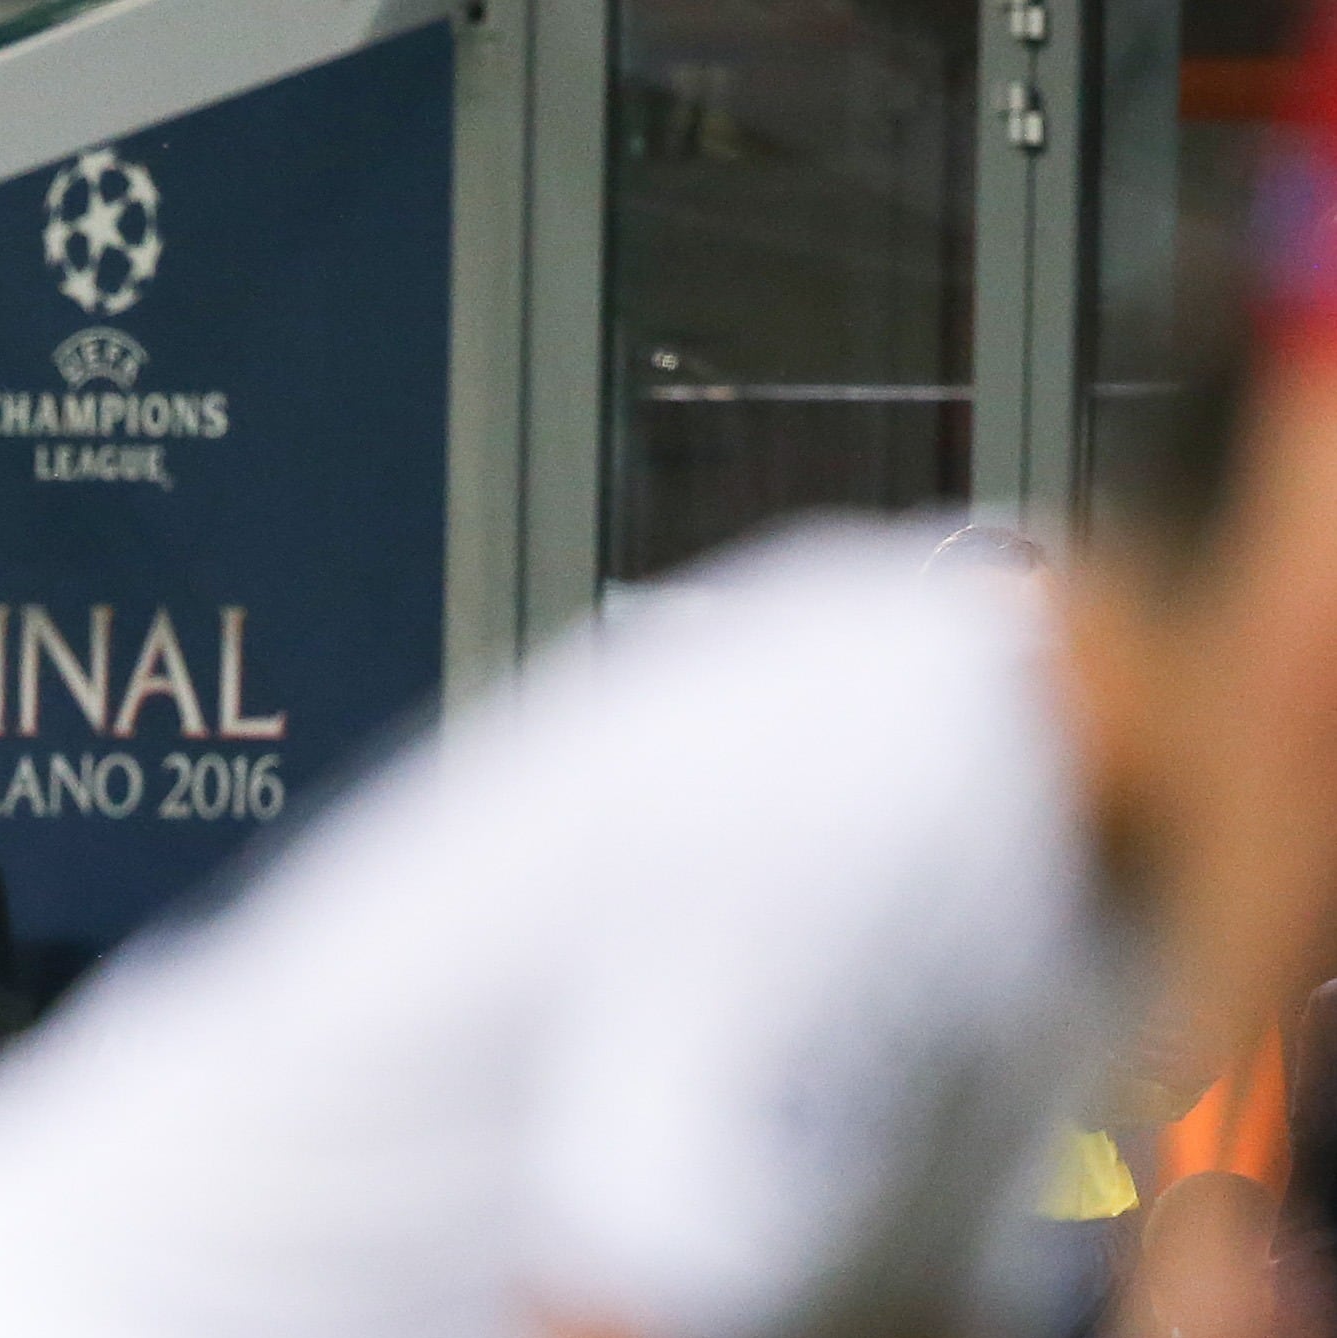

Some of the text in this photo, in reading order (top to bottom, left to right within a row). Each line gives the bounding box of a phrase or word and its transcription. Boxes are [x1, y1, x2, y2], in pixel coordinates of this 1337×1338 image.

[57, 332, 142, 389] UEFA
[34, 444, 166, 483] LEAGUE
[158, 750, 286, 820] 2016
